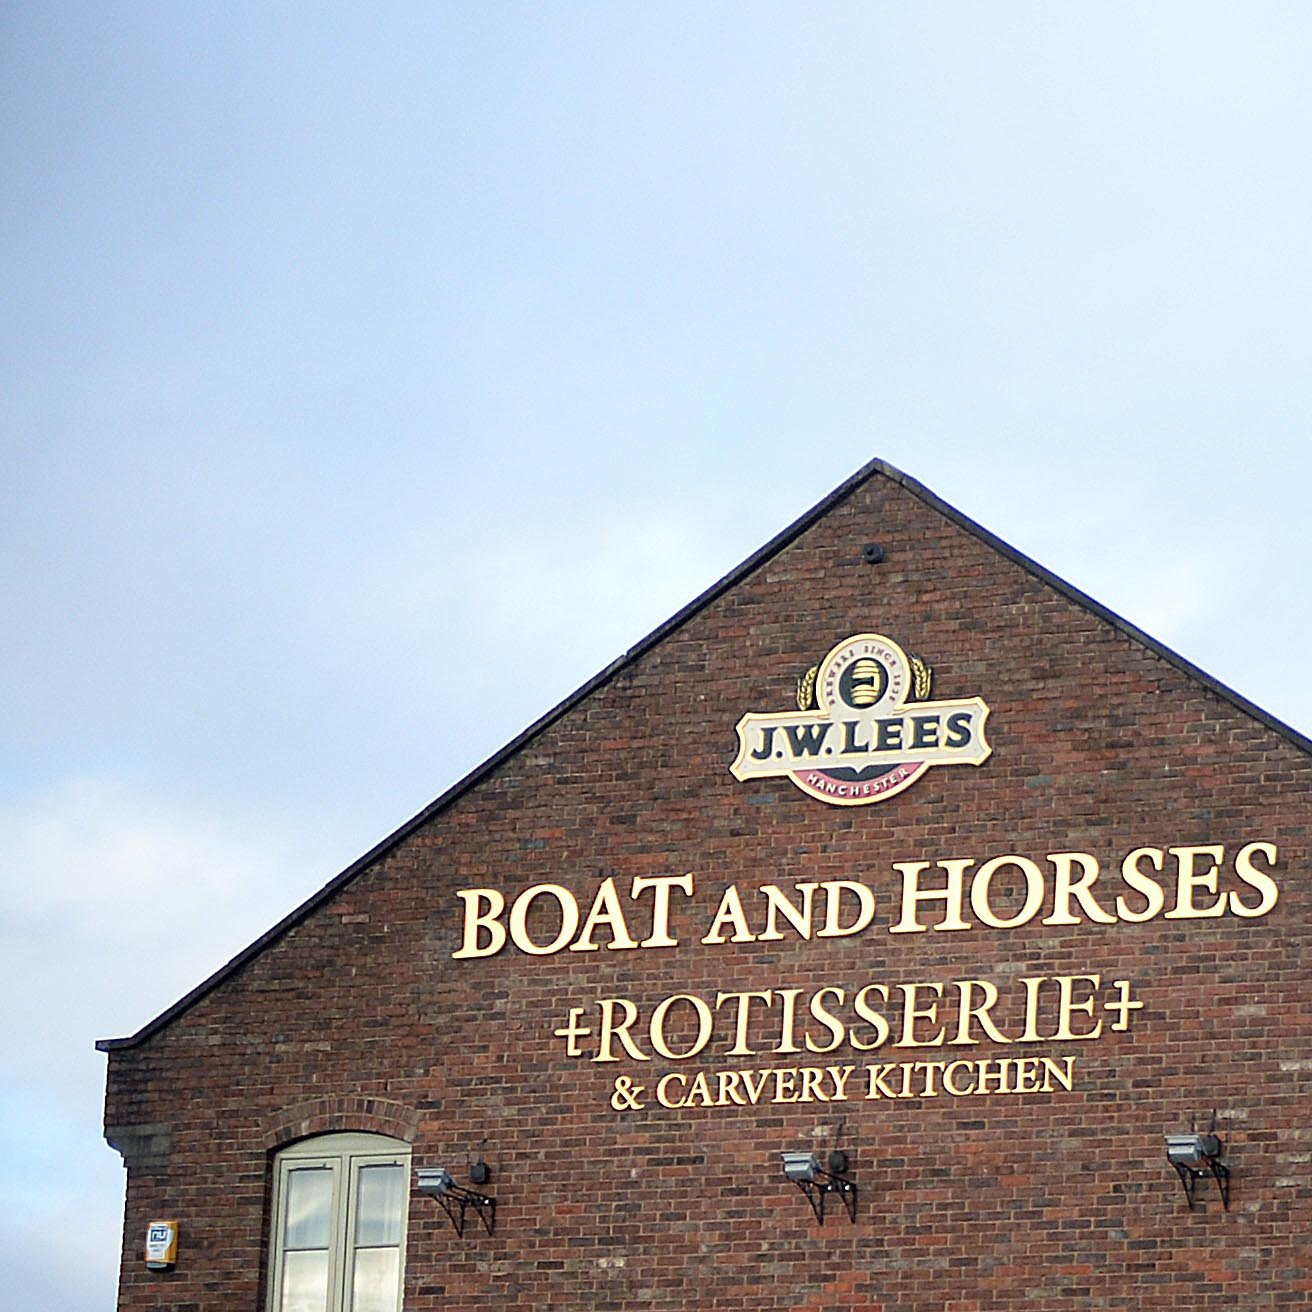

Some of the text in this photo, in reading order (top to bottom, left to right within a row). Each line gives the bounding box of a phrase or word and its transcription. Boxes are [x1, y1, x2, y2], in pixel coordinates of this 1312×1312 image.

[807, 767, 908, 796] MANCHESTER
[451, 841, 1279, 959] BOAT AND HORSES
[590, 974, 1102, 1062] ROTISSERIE
[610, 1056, 1076, 1111] & CARVERY KITCHEN
